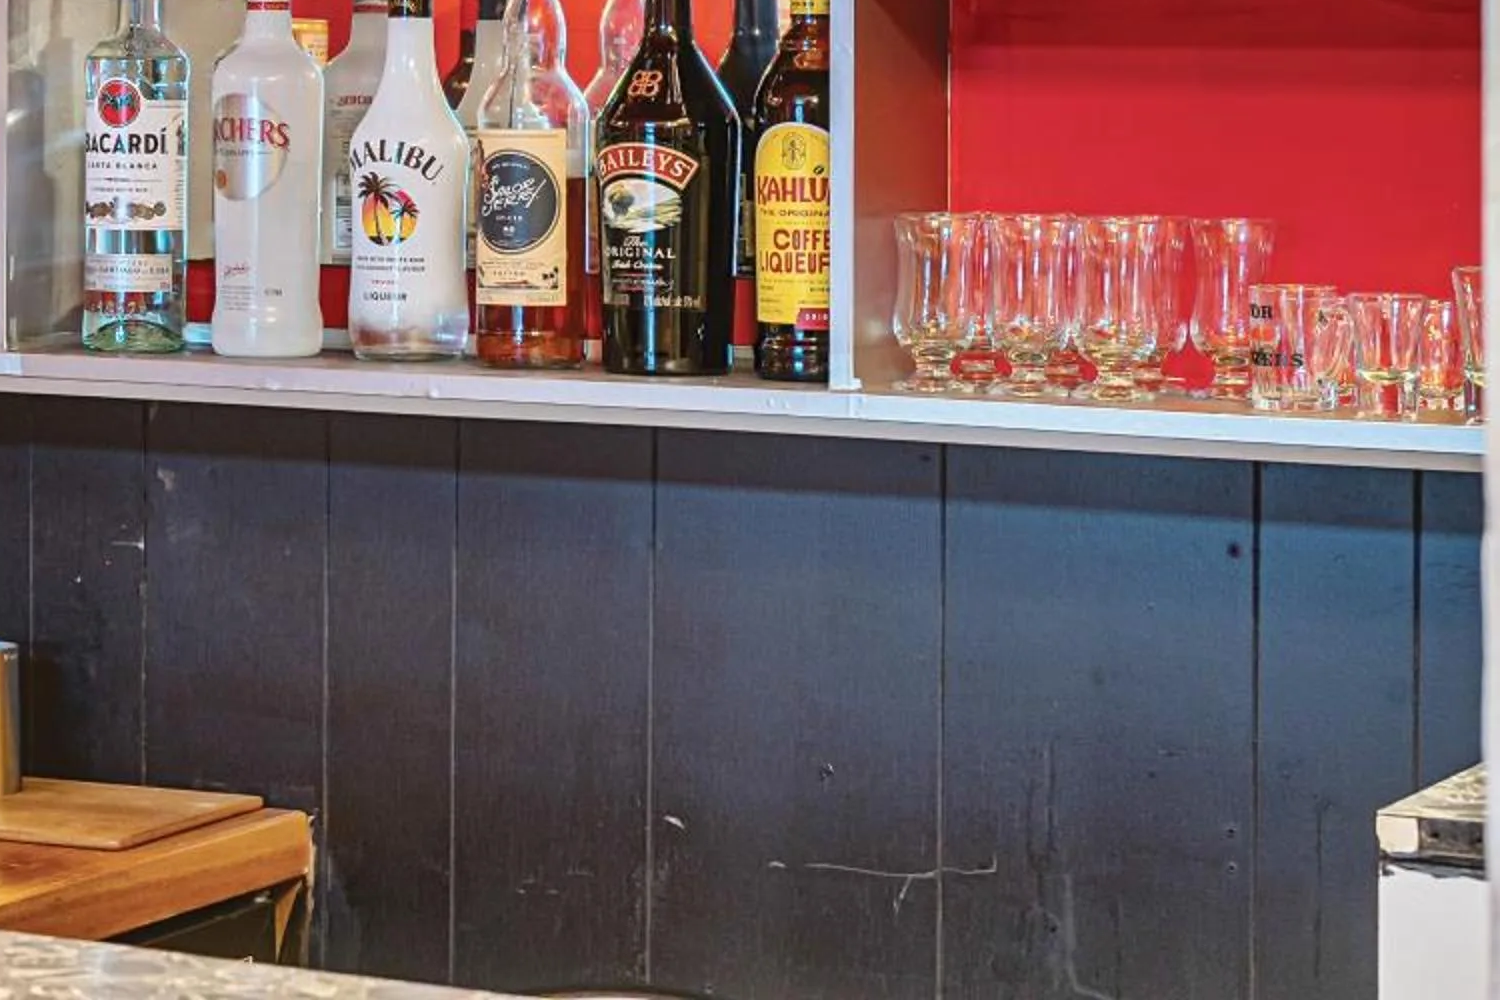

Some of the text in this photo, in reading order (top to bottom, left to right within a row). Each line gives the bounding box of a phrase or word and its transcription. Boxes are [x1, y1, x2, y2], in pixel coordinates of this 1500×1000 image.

[214, 118, 291, 152] RCHERS
[600, 148, 685, 178] BAILEYS
[756, 164, 830, 205] KAHLÚ
[779, 208, 830, 217] ORIGINA
[773, 229, 830, 250] COFFE
[604, 247, 677, 259] ORIGINAL
